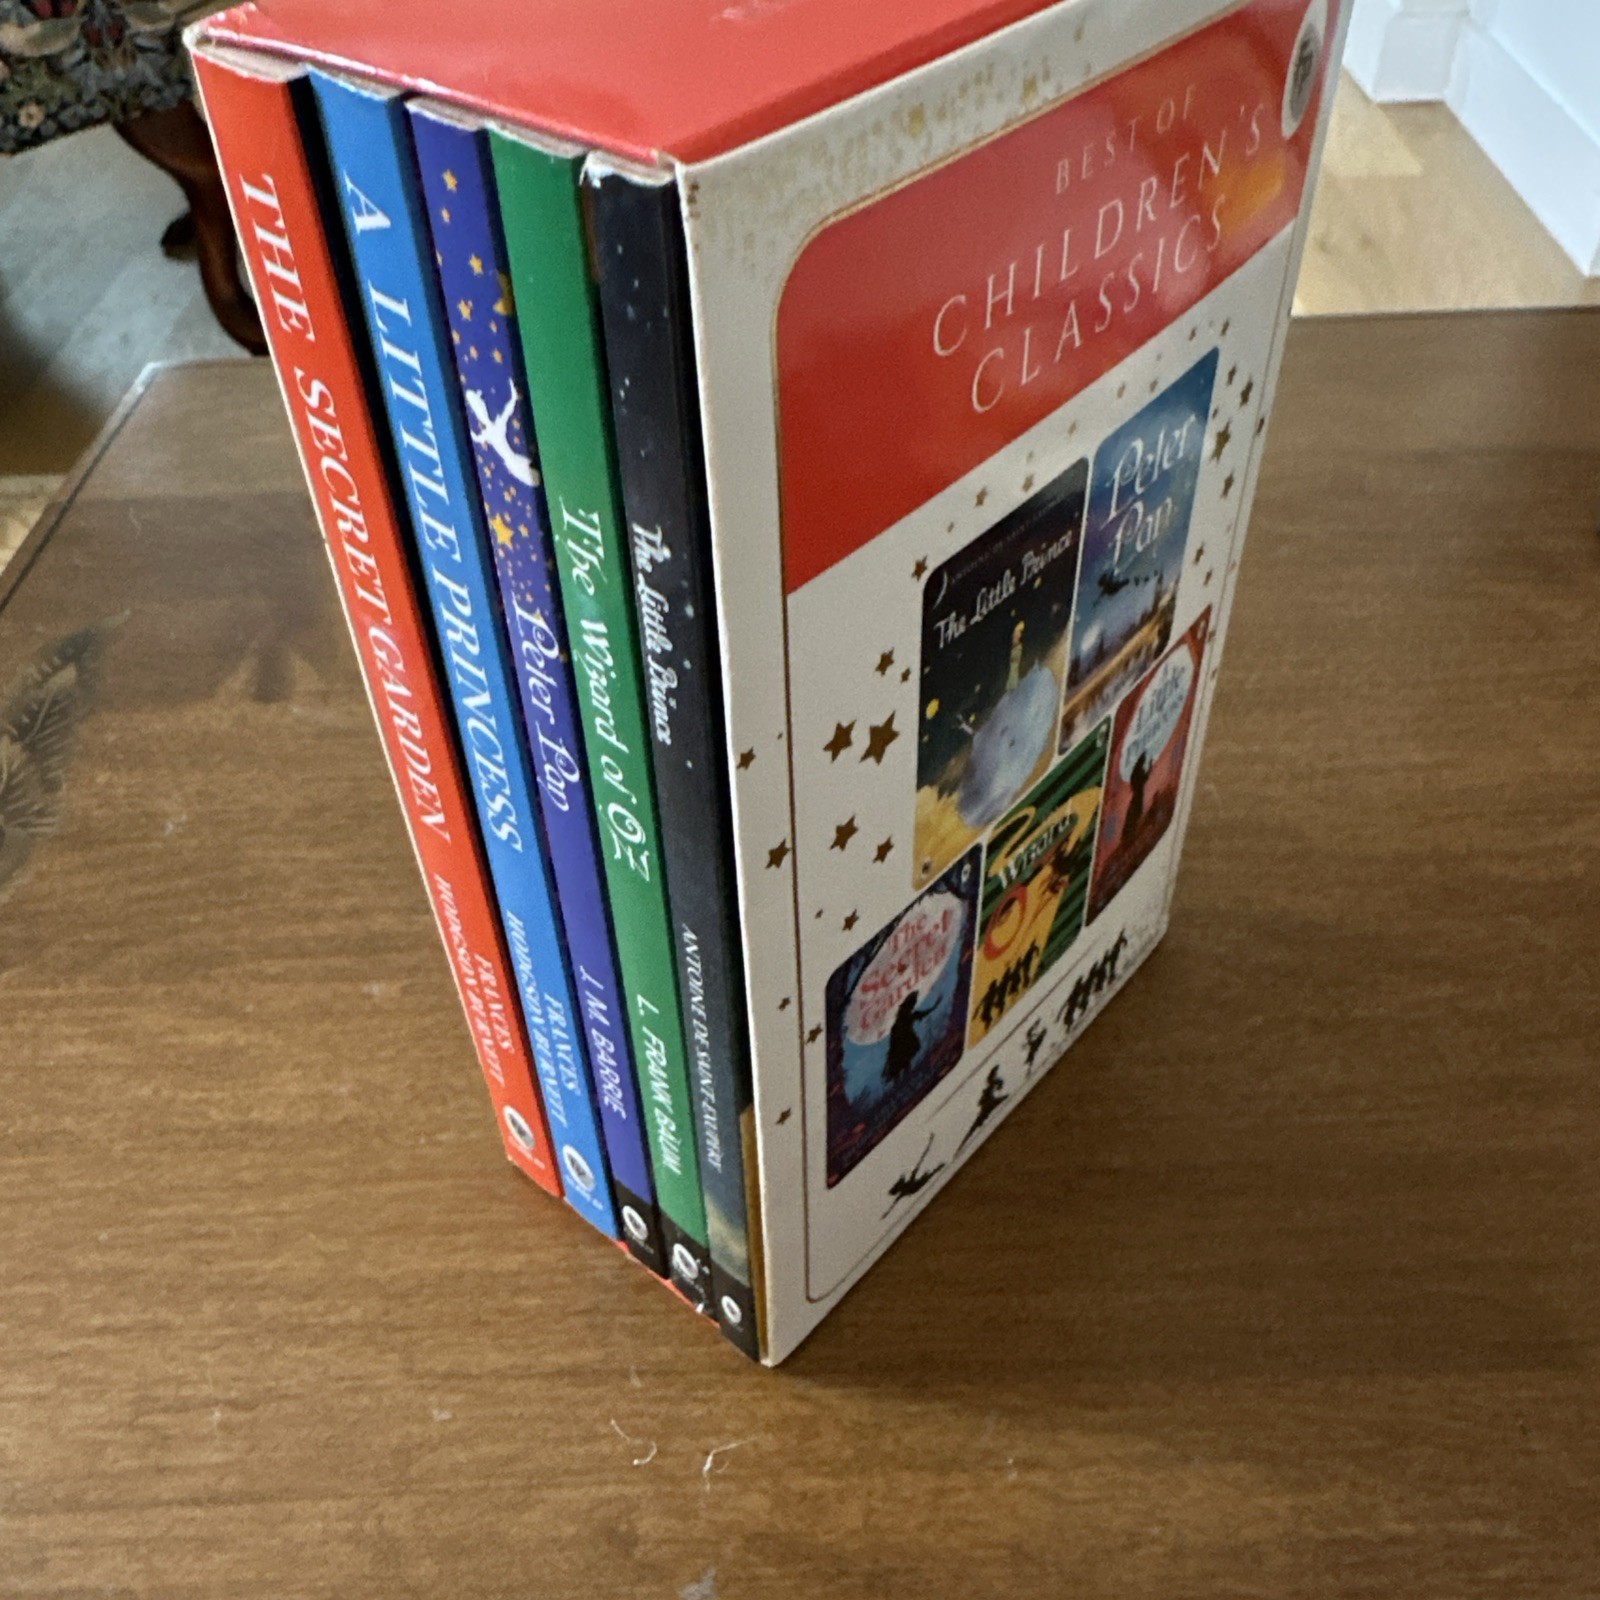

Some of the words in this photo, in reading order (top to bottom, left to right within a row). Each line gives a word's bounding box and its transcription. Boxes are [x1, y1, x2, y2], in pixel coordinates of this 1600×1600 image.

[1056, 117, 1142, 195] BEST
[1156, 84, 1196, 135] OF
[932, 103, 1265, 357] CHILDREN'S
[972, 193, 1226, 413] CLASSICS
[239, 172, 316, 342] THE
[293, 366, 393, 626] SECRET
[367, 626, 451, 845] GARDEN
[342, 169, 391, 237] A
[368, 278, 462, 564] LITTLE
[431, 563, 523, 853] PRINCESS
[1099, 413, 1196, 532] Peter
[555, 495, 608, 596] The
[631, 522, 672, 575] The
[1107, 496, 1173, 577] Pan
[636, 569, 674, 655] Little
[933, 611, 967, 650] The
[970, 569, 1016, 625] Little
[1020, 529, 1074, 587] Prince
[511, 591, 560, 726] Peter
[574, 616, 630, 754] Wizard
[648, 653, 678, 746] Prince
[535, 720, 580, 813] Pan
[600, 753, 640, 805] of
[636, 993, 660, 1017] L.
[680, 922, 708, 1020] ANTOINE
[590, 1028, 628, 1120] BARRIE
[641, 1025, 675, 1113] FRANK
[692, 1016, 711, 1051] DE
[654, 1107, 683, 1176] BAUM
